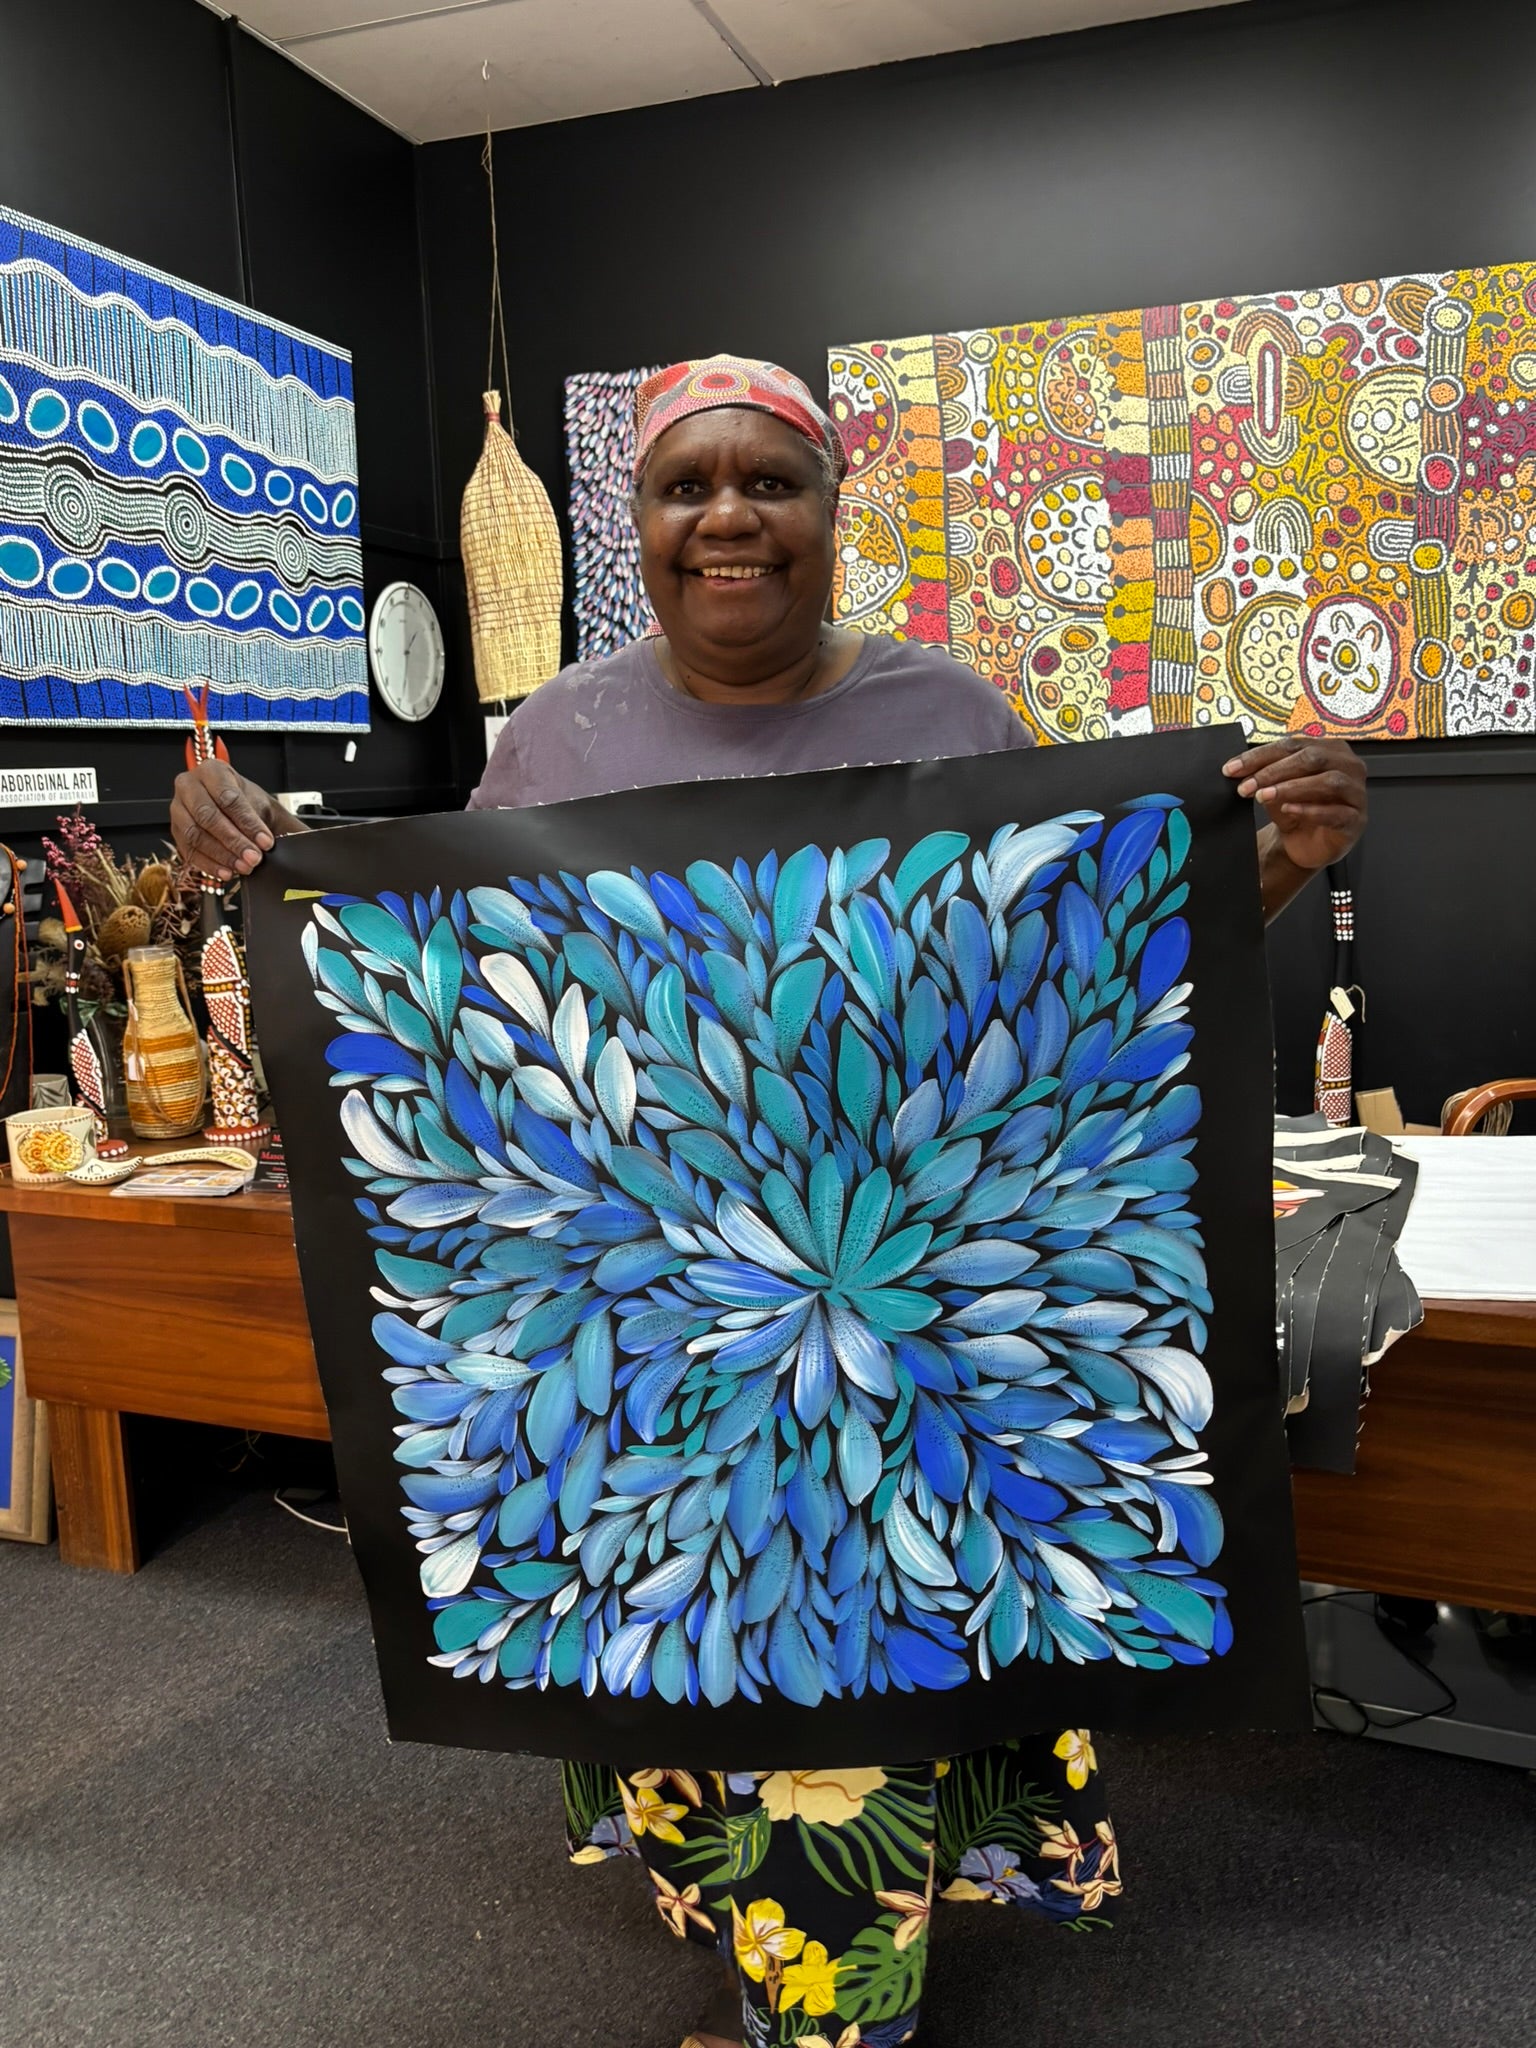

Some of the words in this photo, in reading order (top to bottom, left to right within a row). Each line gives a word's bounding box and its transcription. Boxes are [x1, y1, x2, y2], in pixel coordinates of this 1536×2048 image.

[1, 774, 69, 792] ABORIGINAL
[73, 773, 93, 790] ART
[0, 793, 46, 803] ASSOCIATION
[48, 792, 57, 801] OF
[59, 791, 95, 801] AUSTRALIA
